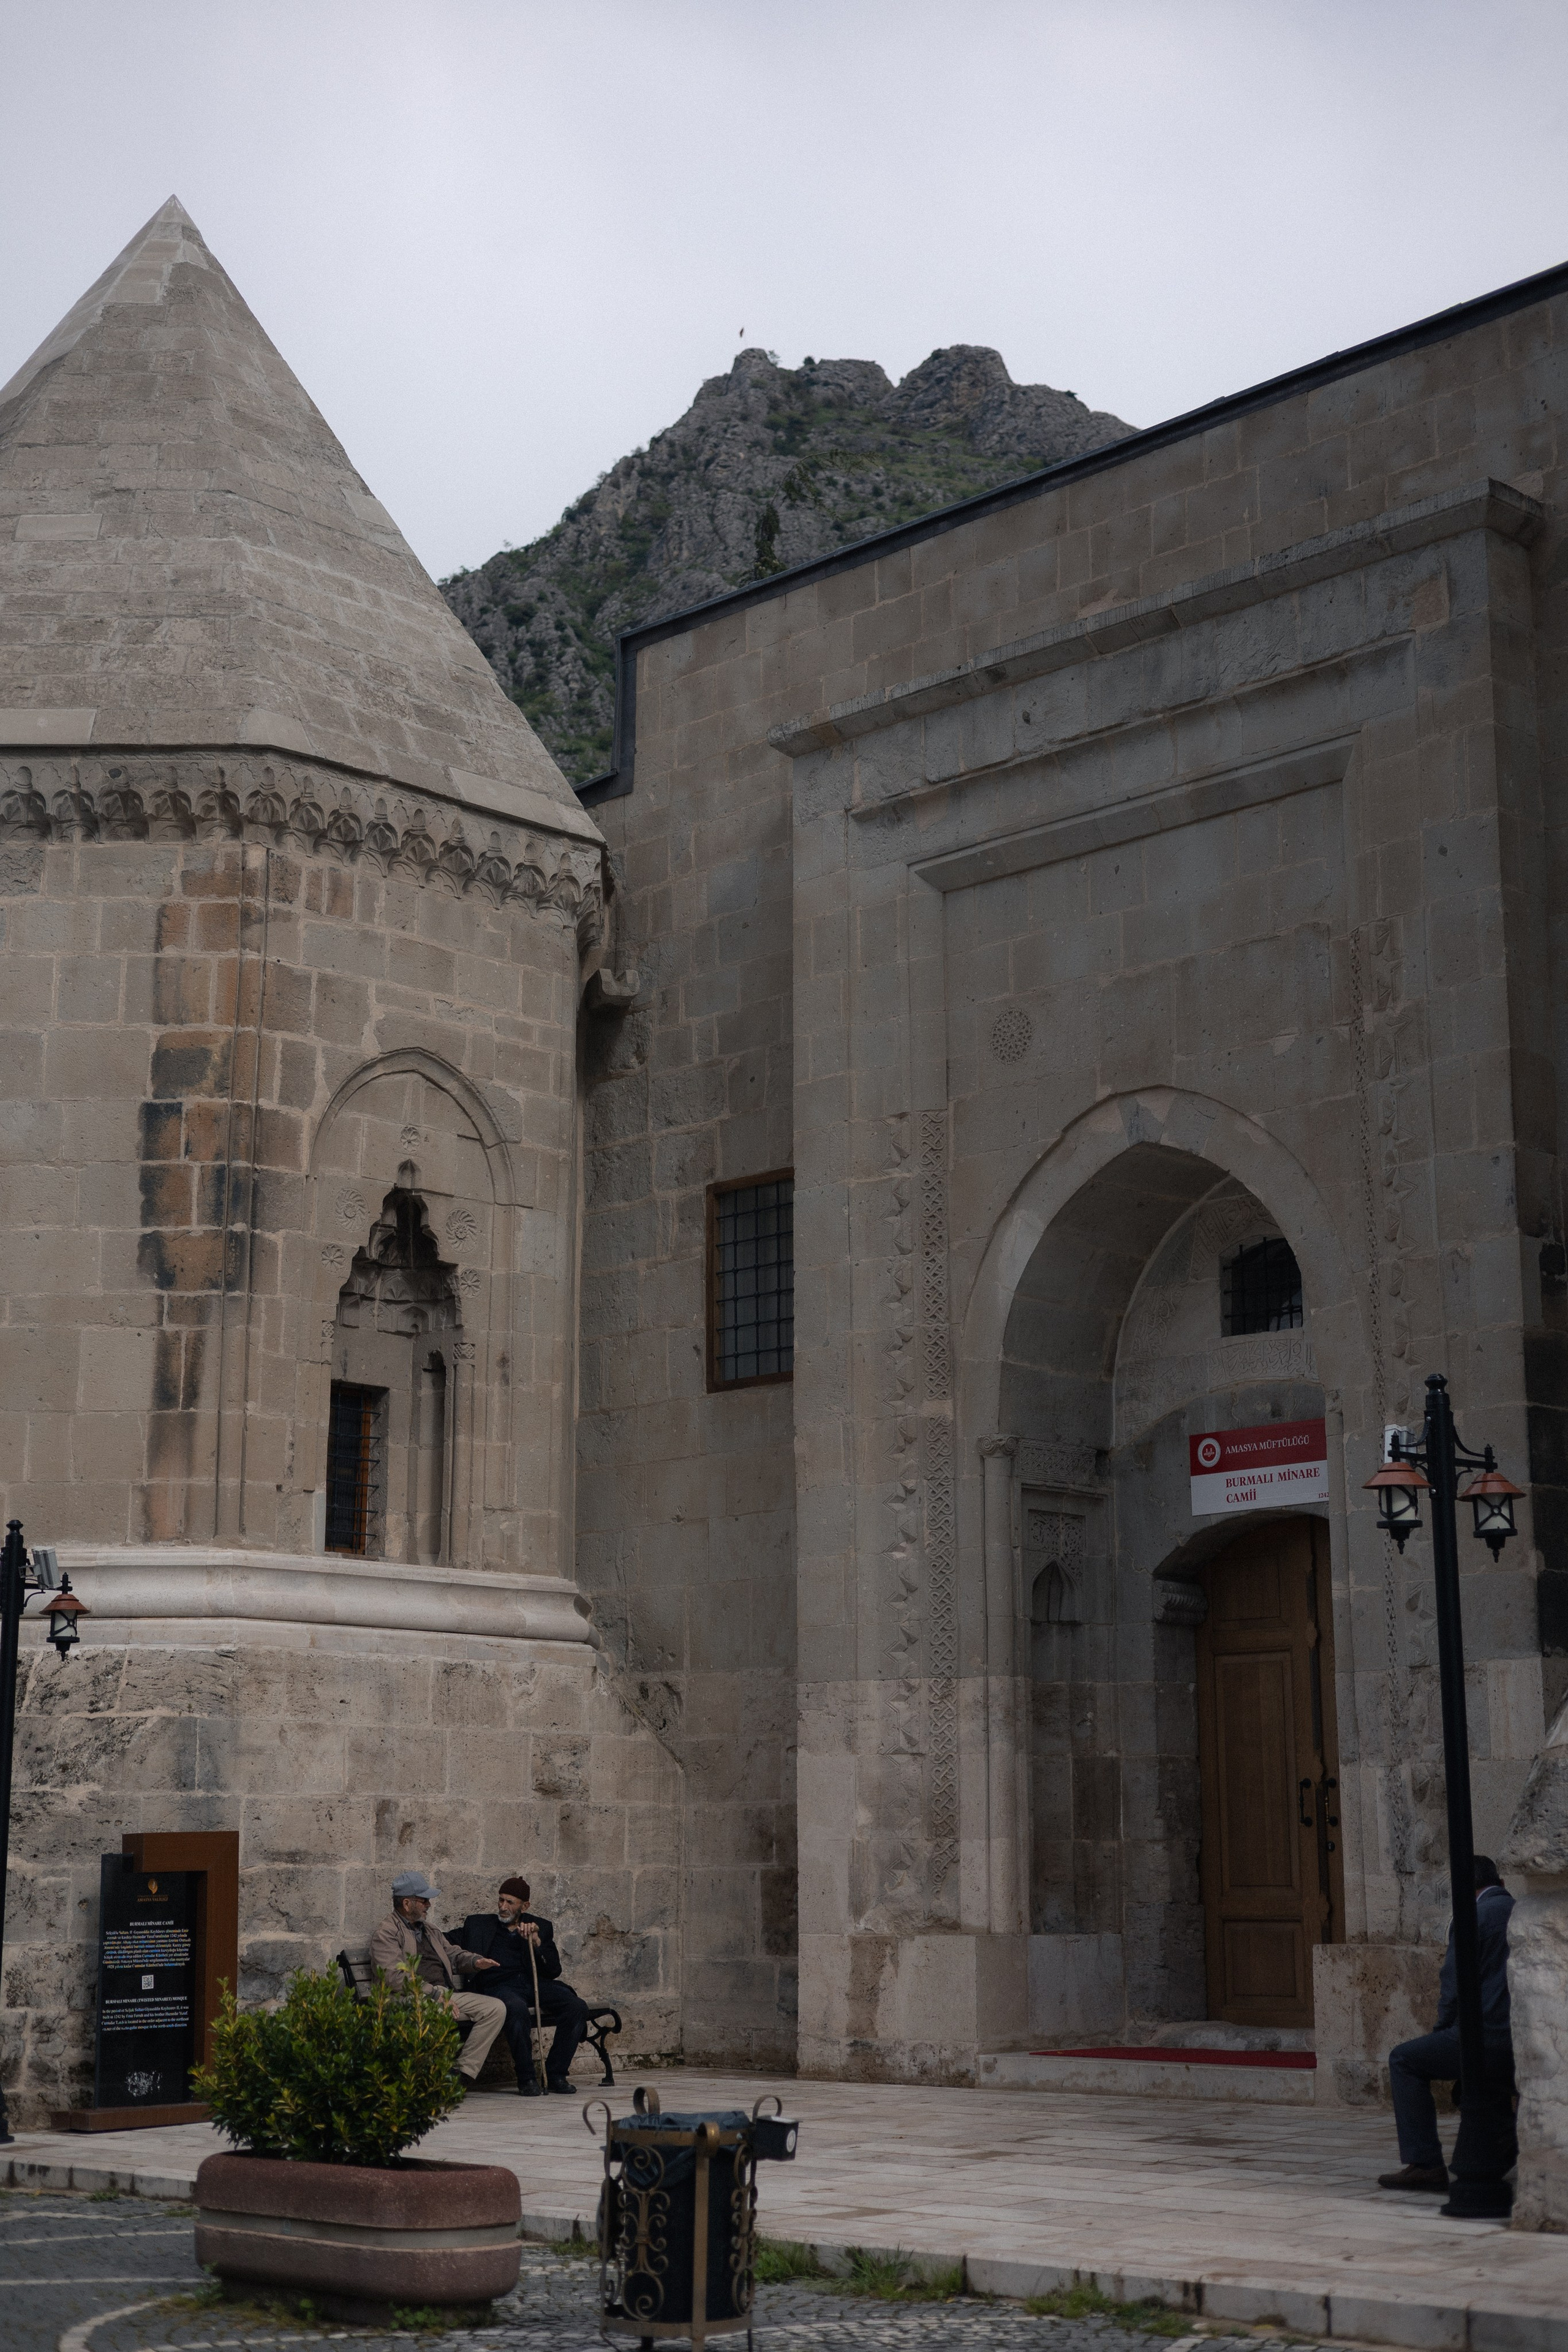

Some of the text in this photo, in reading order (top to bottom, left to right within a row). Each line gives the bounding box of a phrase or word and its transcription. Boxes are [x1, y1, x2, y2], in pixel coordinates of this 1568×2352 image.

[1225, 1443, 1258, 1454] AMASYA
[1259, 1434, 1310, 1450] MÜFTÜLÜĞÜ
[1225, 1468, 1320, 1488] BURMALI MİNARE
[1226, 1488, 1257, 1504] CAMİİ
